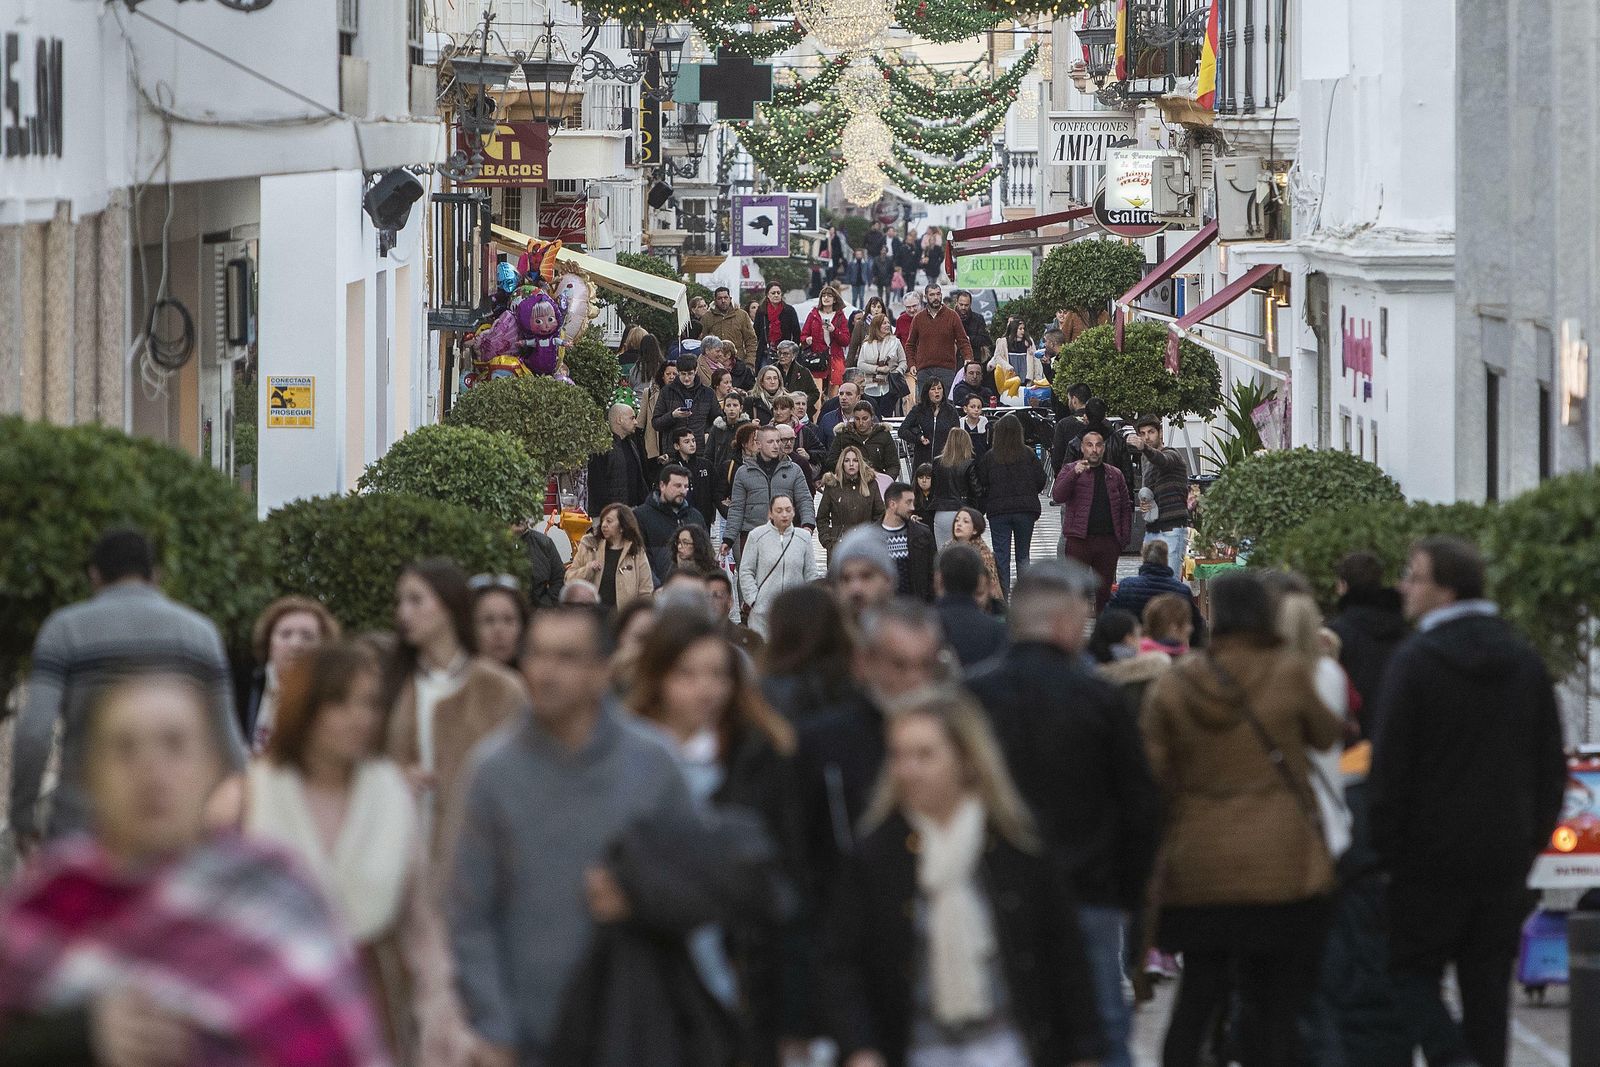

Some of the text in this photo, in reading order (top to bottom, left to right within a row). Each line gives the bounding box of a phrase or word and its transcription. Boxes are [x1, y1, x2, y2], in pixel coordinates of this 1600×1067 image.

[1053, 121, 1129, 132] CONFECCIONES
[1052, 134, 1130, 161] AMPAR
[468, 164, 543, 176] BACOS
[790, 199, 813, 207] RIS
